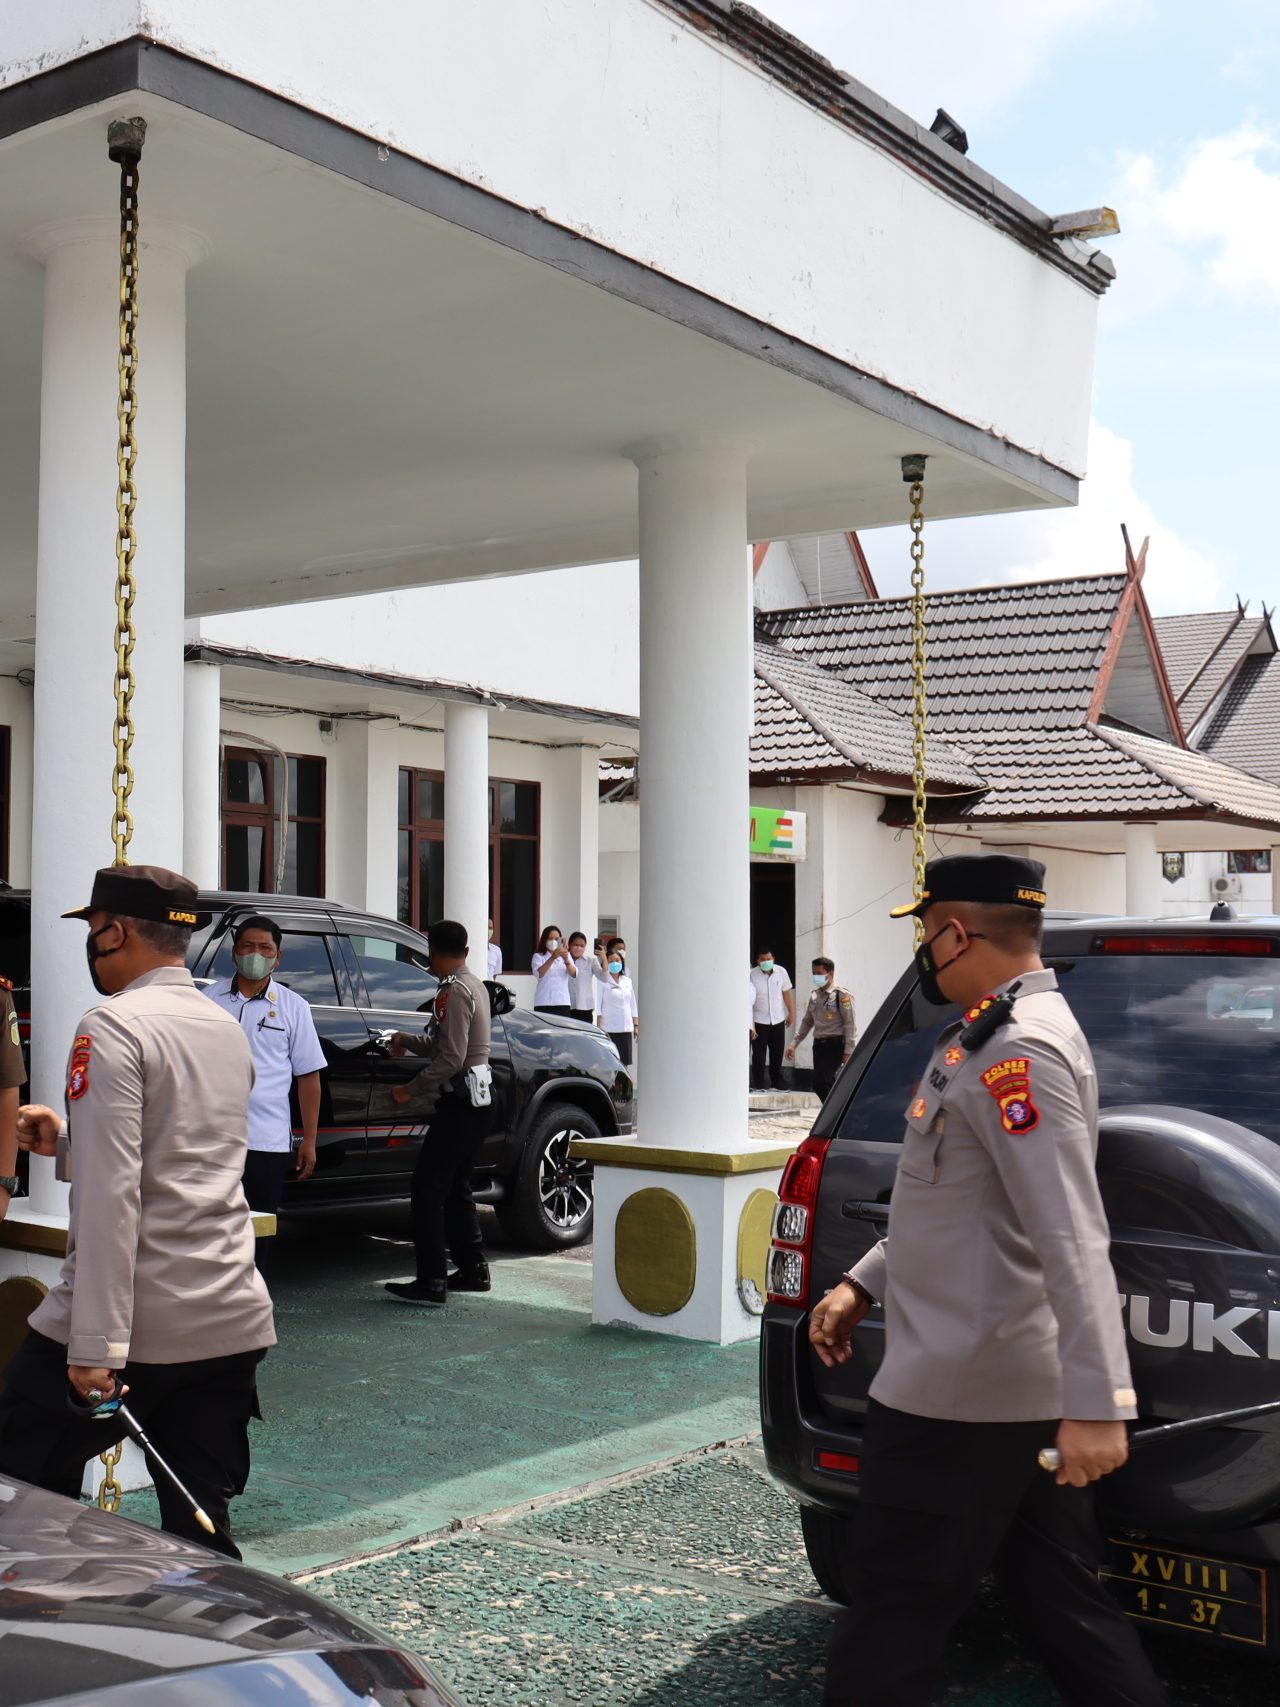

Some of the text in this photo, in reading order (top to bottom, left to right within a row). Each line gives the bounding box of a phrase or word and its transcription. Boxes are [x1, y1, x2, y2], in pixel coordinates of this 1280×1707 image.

[984, 1060, 1026, 1080] POLRES
[1119, 1293, 1280, 1360] UKI
[1131, 1551, 1227, 1592] XVIII
[1190, 1598, 1222, 1625] 37
